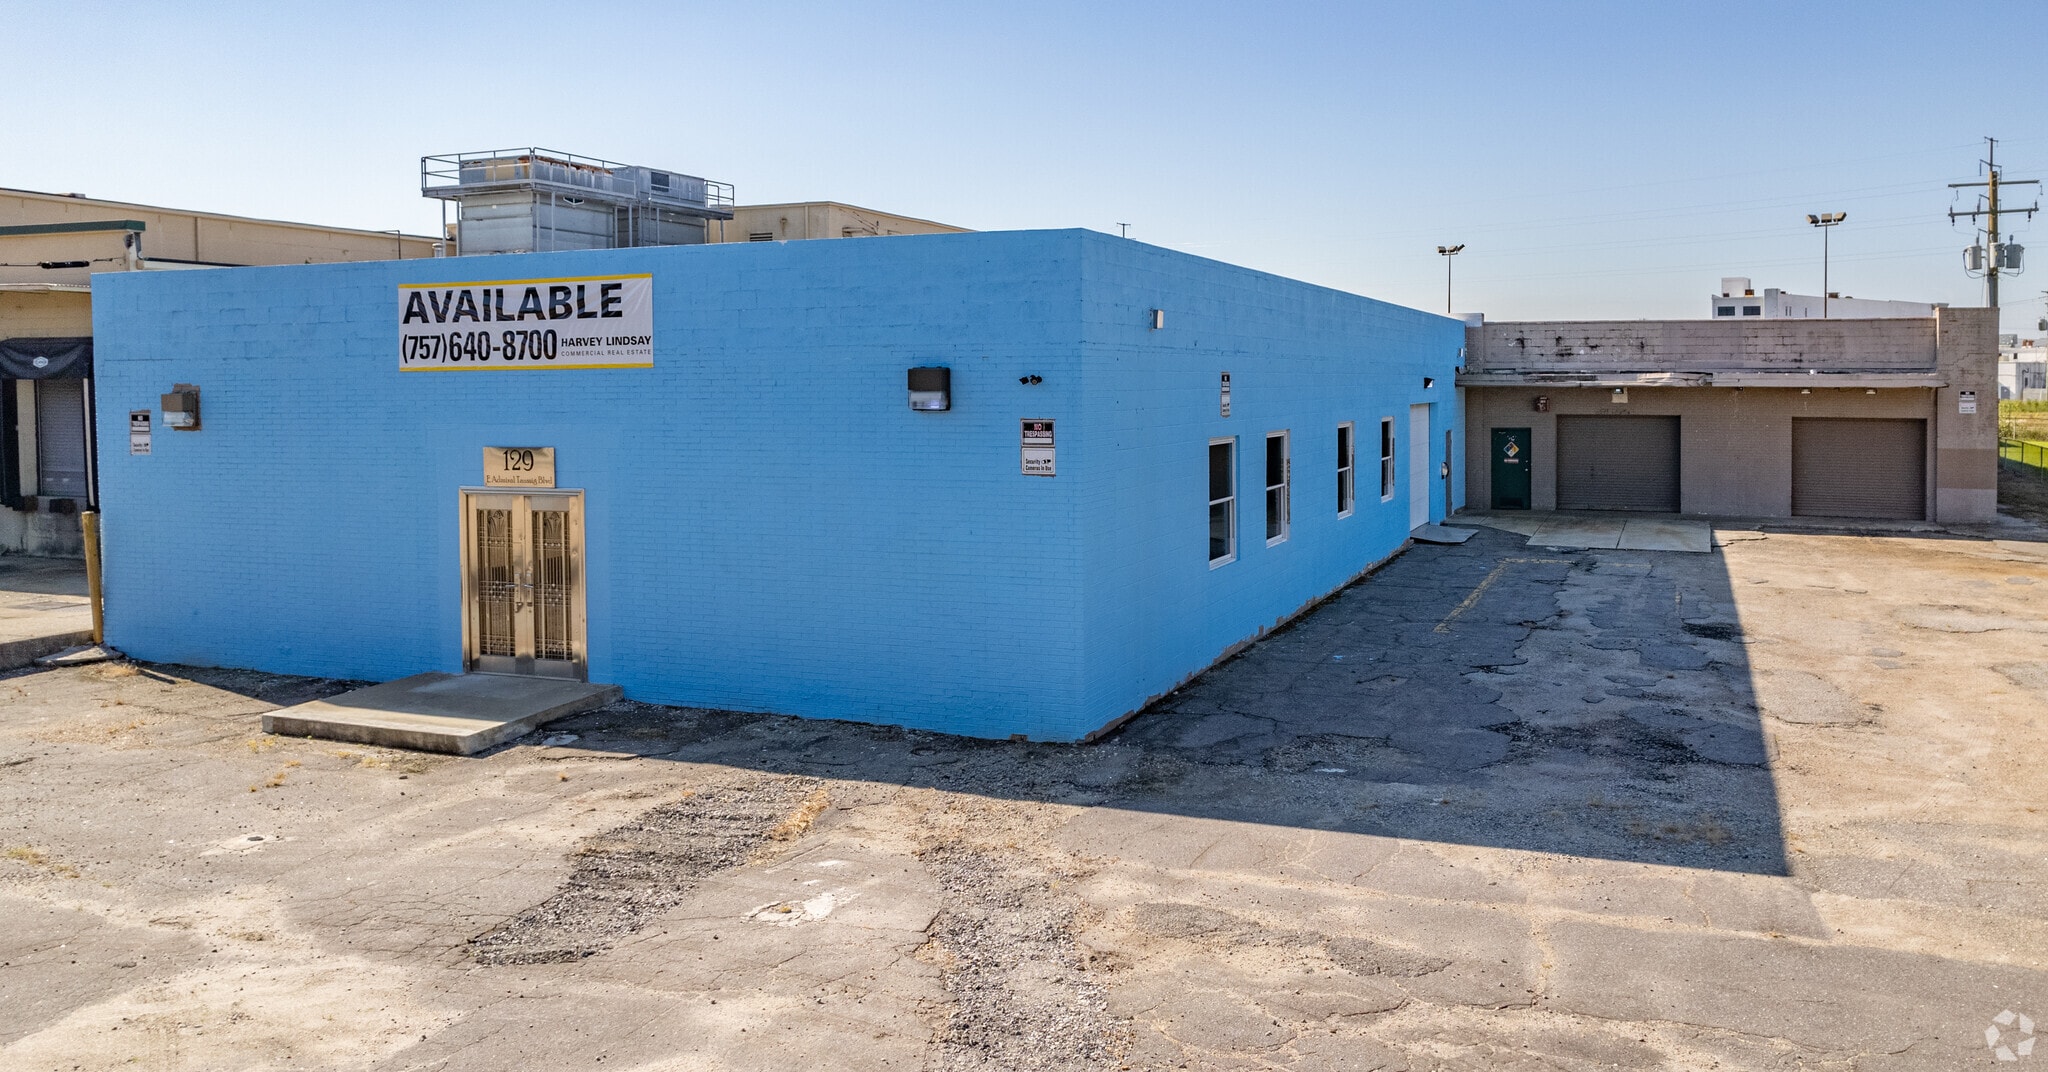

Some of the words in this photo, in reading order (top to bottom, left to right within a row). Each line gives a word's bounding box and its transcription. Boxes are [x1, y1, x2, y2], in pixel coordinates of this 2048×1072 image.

[402, 282, 623, 324] AVAILABLE
[561, 336, 603, 347] HARVEY
[606, 335, 652, 346] LINDSAY
[503, 449, 534, 471] 129
